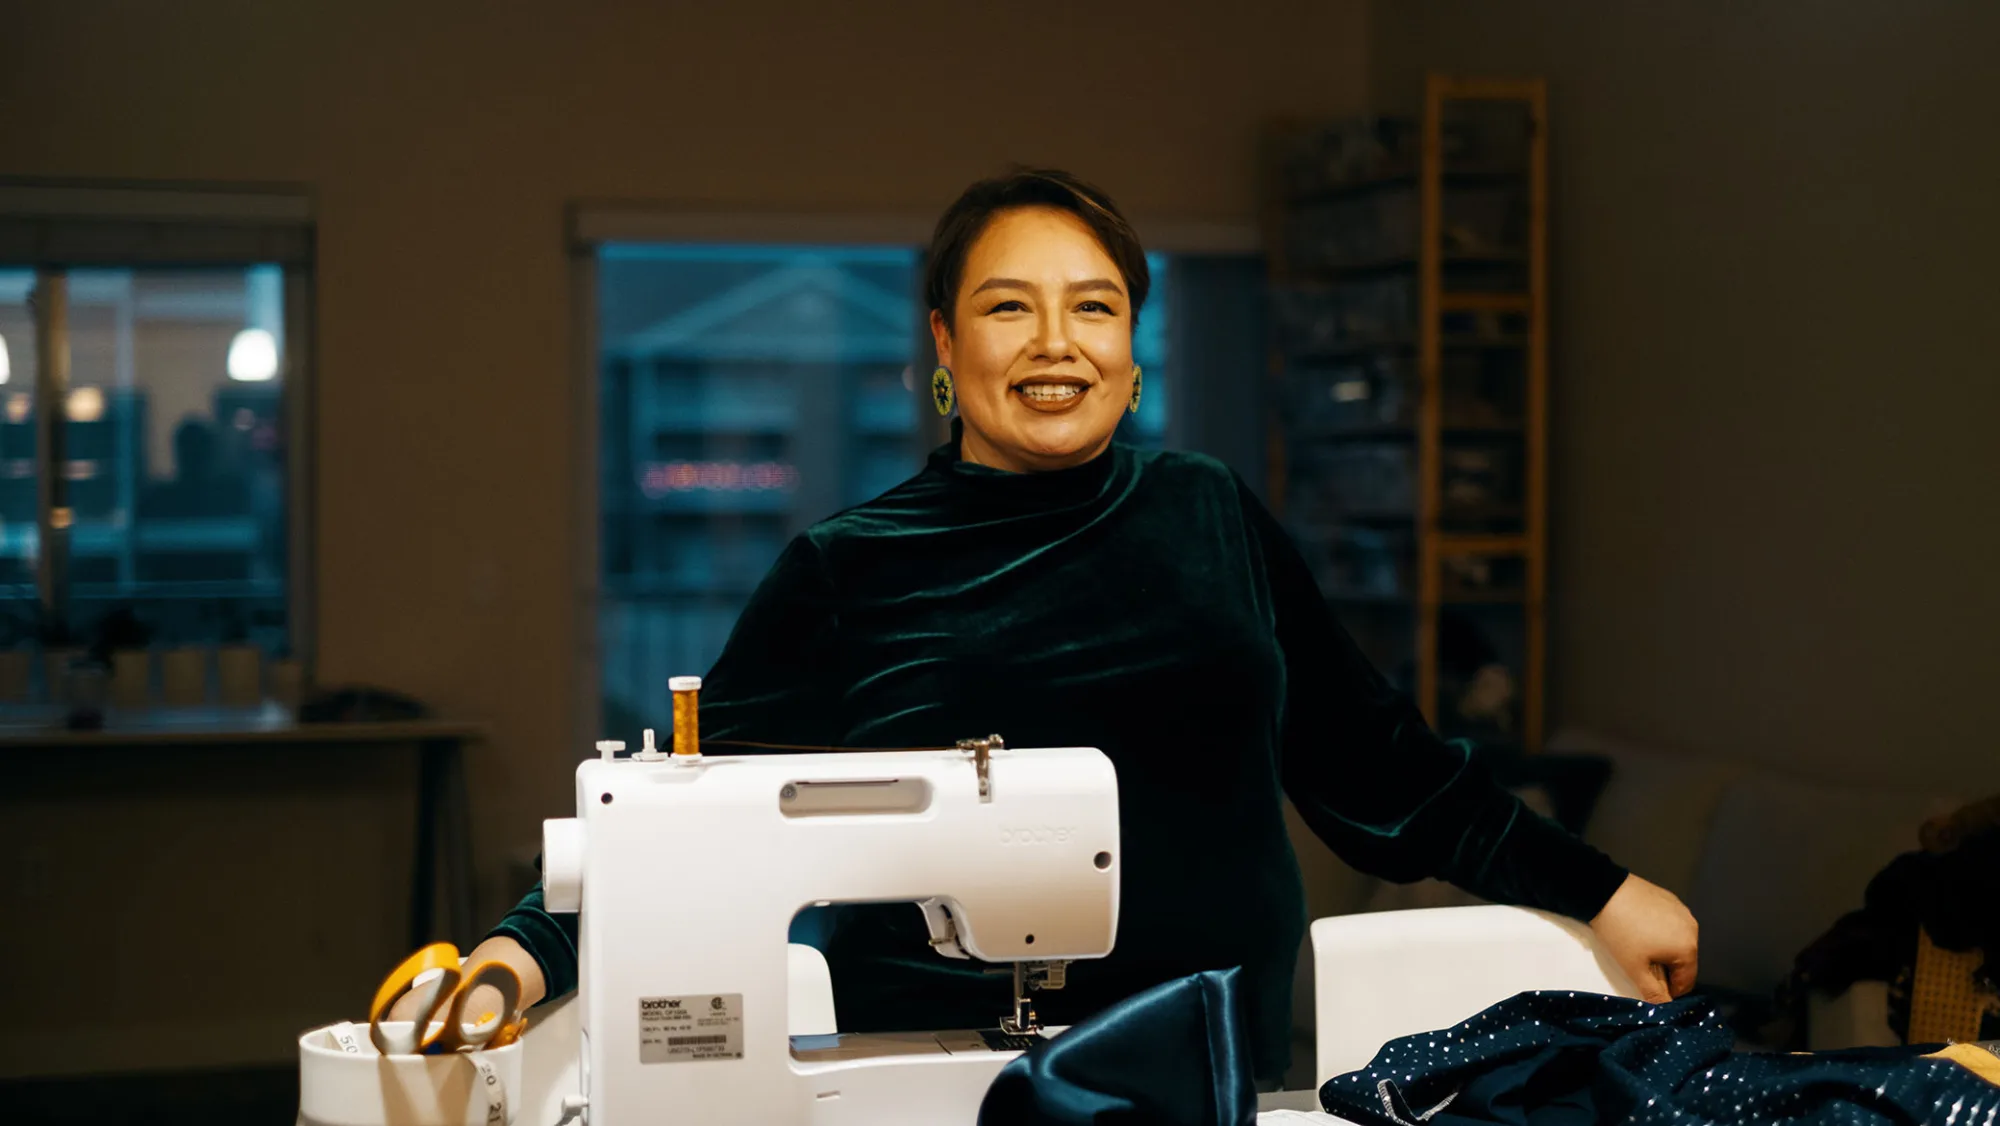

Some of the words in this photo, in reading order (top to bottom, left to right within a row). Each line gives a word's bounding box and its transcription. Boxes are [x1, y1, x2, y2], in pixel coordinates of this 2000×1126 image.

[998, 824, 1077, 846] brother
[642, 999, 682, 1009] brother
[490, 1101, 502, 1122] 21
